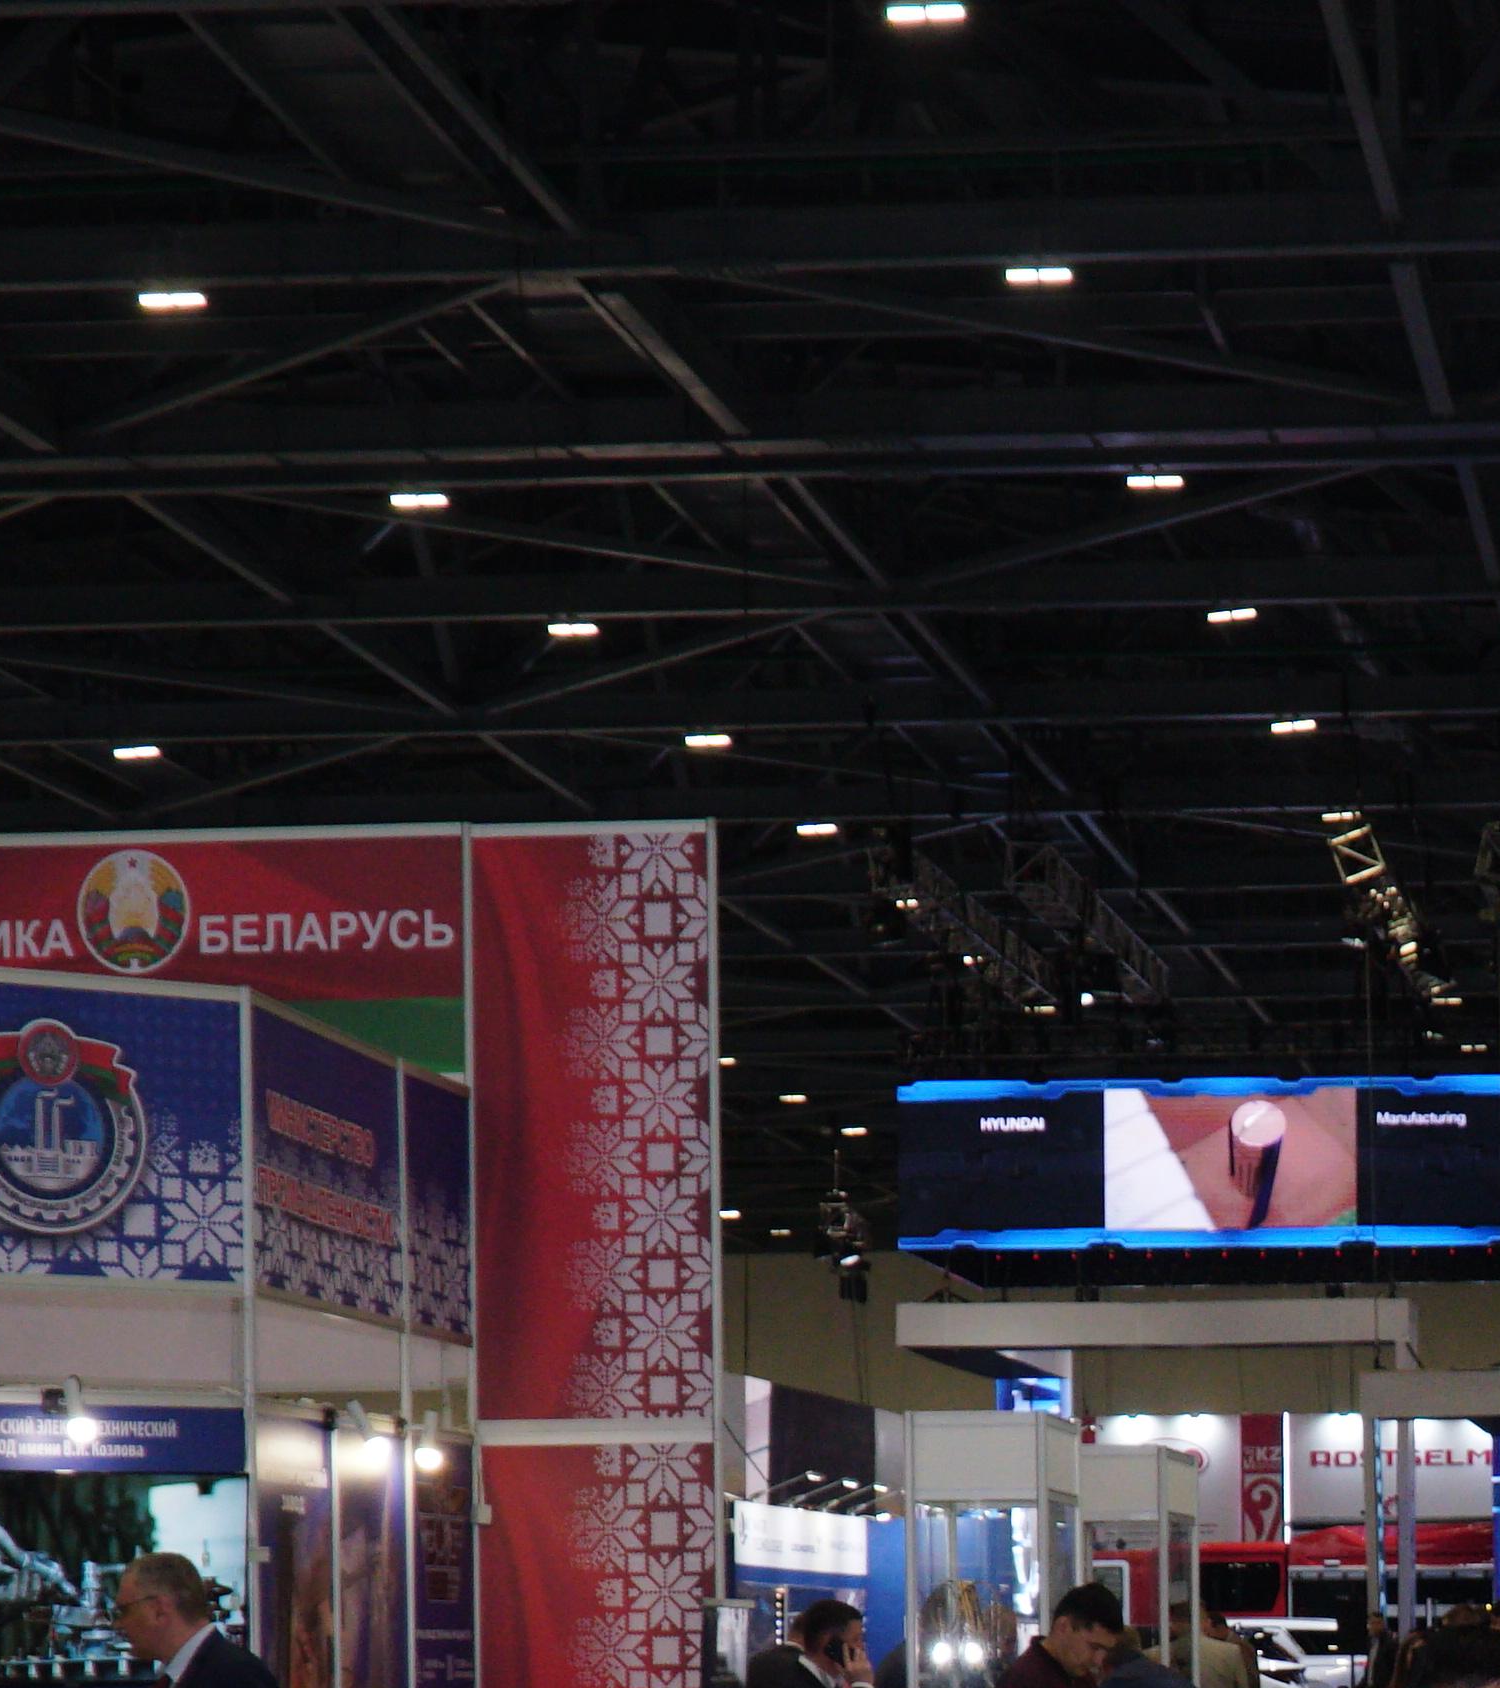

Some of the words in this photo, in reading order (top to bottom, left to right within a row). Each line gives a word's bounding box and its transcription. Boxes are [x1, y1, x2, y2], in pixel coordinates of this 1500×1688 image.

[200, 909, 454, 956] БЕЛАРУСЬ
[979, 1115, 1046, 1133] HYUNDAI
[1375, 1109, 1468, 1130] Manufacturing
[18, 1442, 62, 1457] имени
[91, 1441, 145, 1459] Козлова
